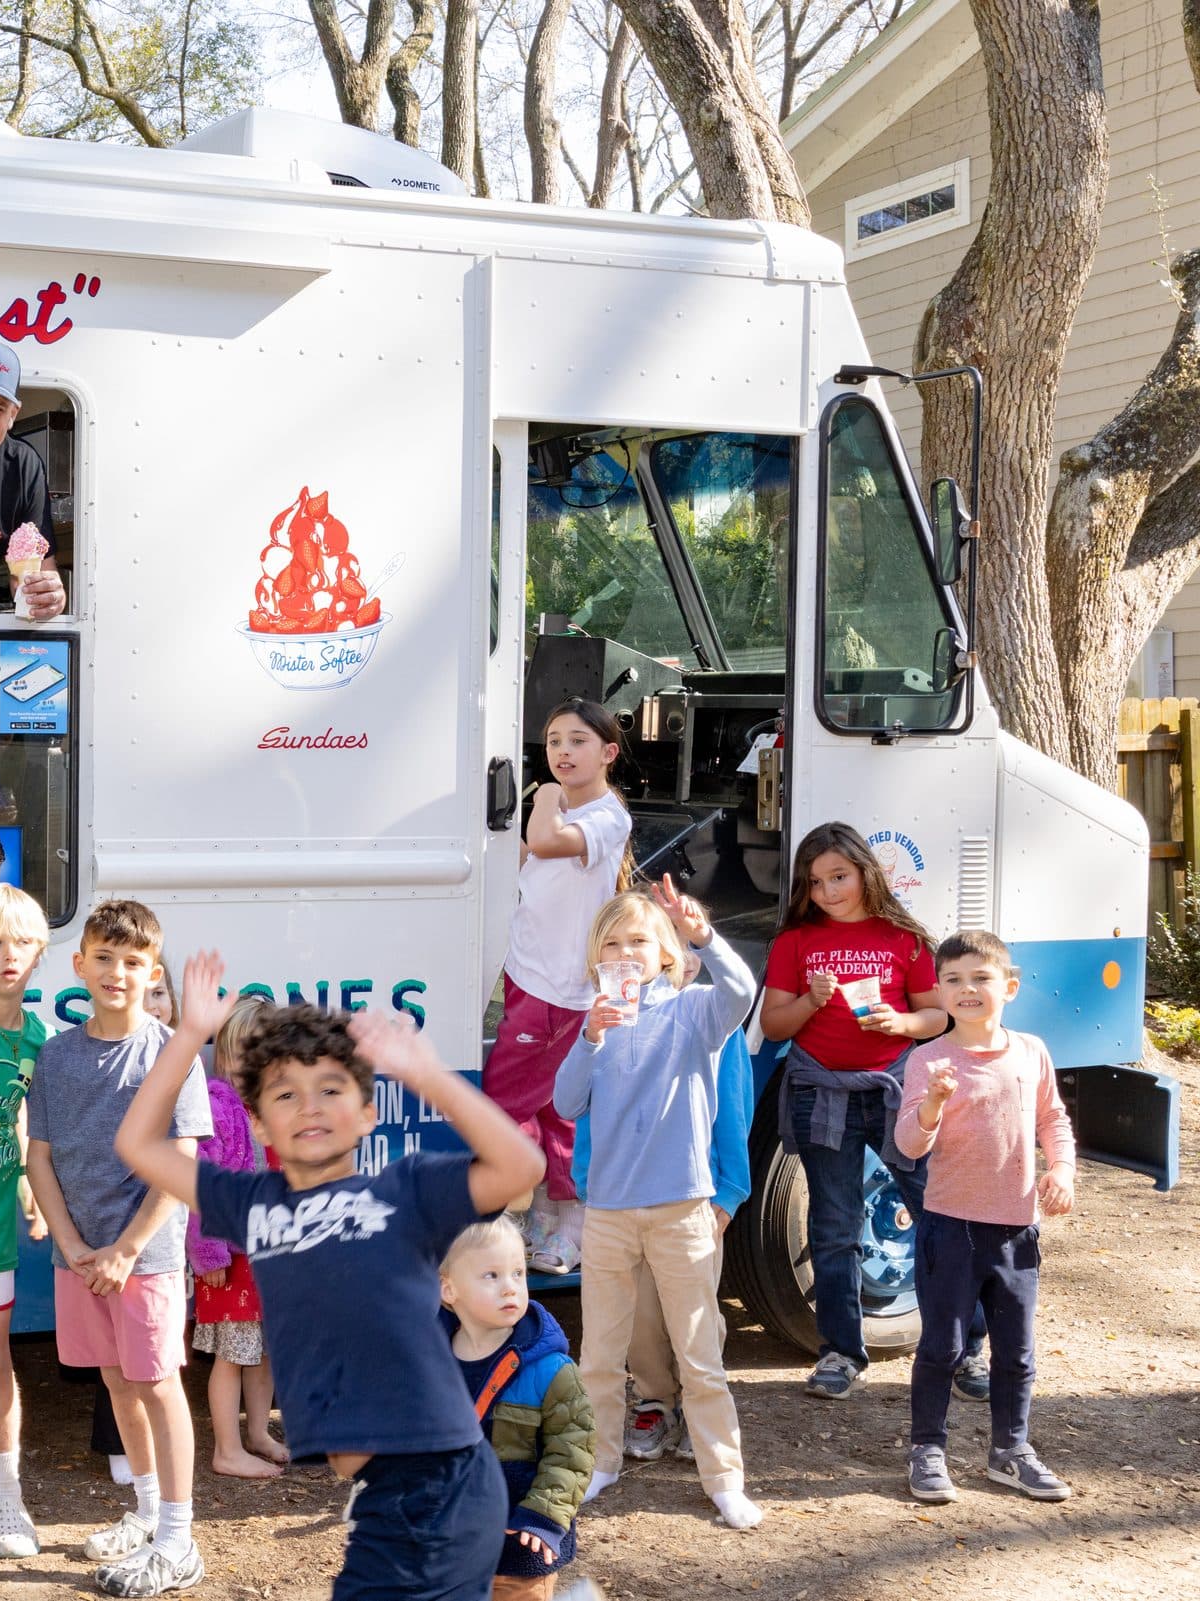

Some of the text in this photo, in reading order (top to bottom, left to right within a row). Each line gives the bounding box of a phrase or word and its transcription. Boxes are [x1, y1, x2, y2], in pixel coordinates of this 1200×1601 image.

[403, 179, 441, 191] DOMETIC
[269, 645, 365, 673] Mister Softee
[257, 726, 369, 749] Sundaes
[895, 831, 925, 872] VENDOR
[829, 949, 895, 963] PLEASANT
[816, 963, 880, 975] ACADEMY
